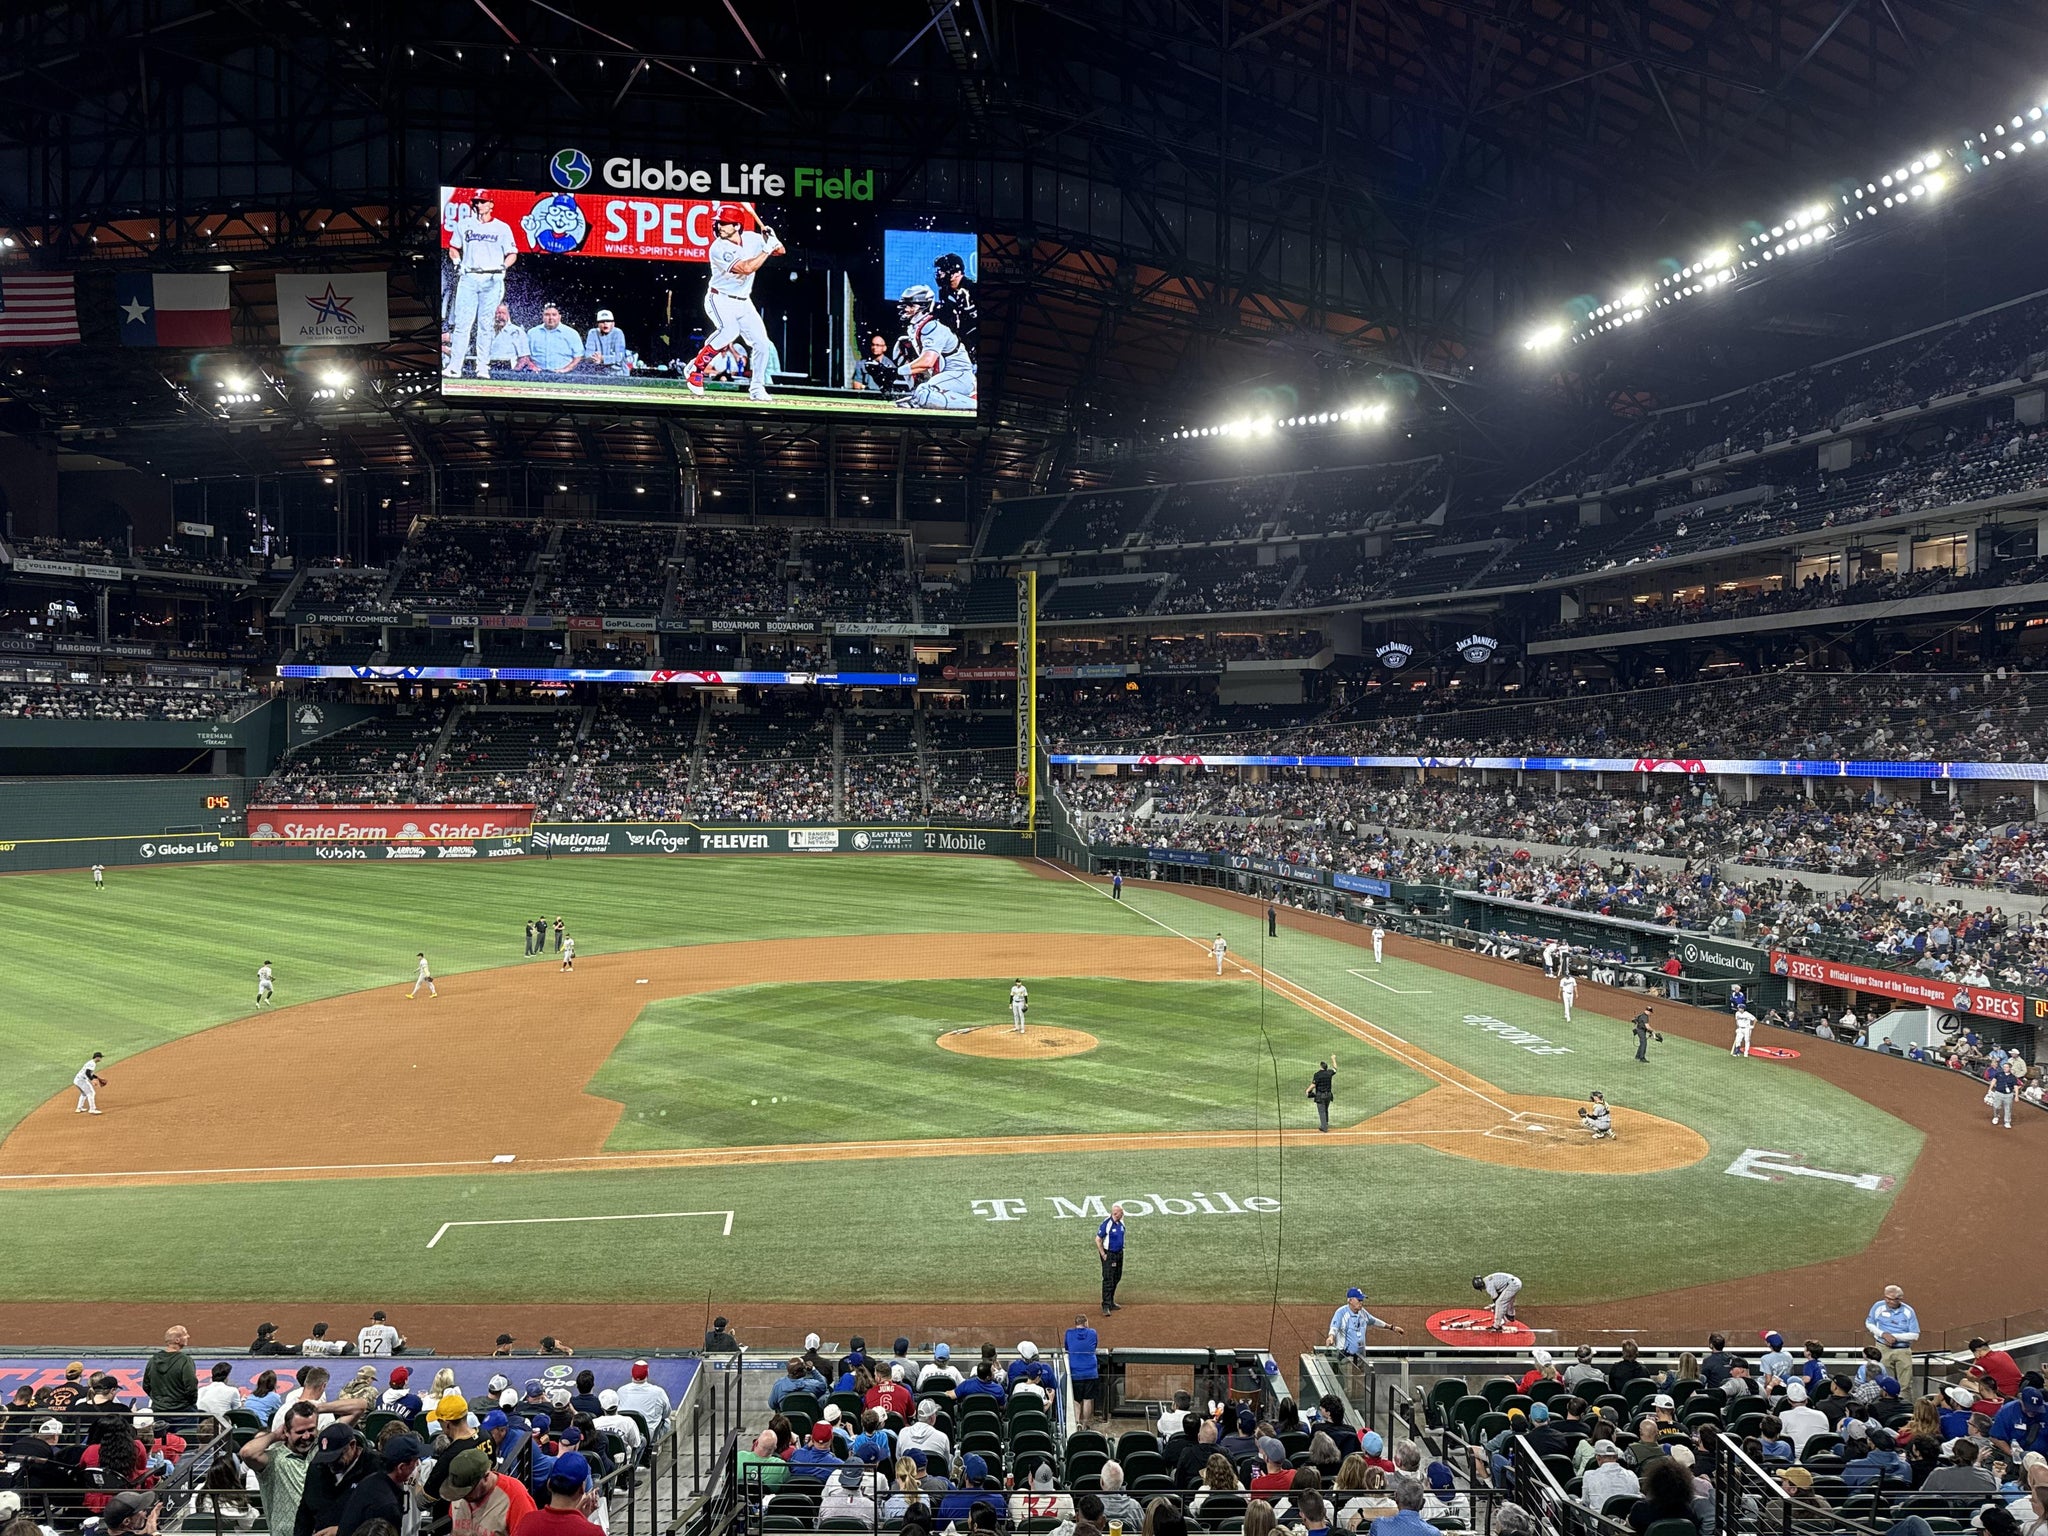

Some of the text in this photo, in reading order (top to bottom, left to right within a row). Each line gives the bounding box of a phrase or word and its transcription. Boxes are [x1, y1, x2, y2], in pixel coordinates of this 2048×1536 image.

[603, 157, 874, 202] Globe Life Field
[605, 244, 706, 258] WINES SPIRITS FINER
[299, 325, 365, 336] ARLINGTON
[319, 614, 399, 624] PRIORITY COMMERCE
[451, 616, 479, 625] 105.3
[481, 616, 503, 626] THE
[578, 619, 600, 628] PGL
[605, 620, 653, 629] GoPGL.com
[666, 621, 687, 629] PGL
[712, 620, 760, 630] BODYARMOR
[767, 622, 814, 632] BODYARMOR
[838, 624, 862, 634] Blue
[1, 640, 35, 650] GOLD
[1018, 601, 1029, 676] CHIKIN
[1456, 634, 1499, 652] JACK DANIEL'S
[56, 643, 151, 655] HARGROVE ROOFING
[169, 649, 228, 660] PLUCKERS
[1375, 641, 1414, 658] JACK DANIEL'S
[1018, 679, 1029, 708] IZ
[207, 796, 229, 809] 0:45
[646, 829, 690, 853] Kroger
[939, 833, 986, 850] Mobile
[1021, 832, 1032, 840] 326
[158, 841, 219, 855] Globe Life
[316, 847, 367, 858] Kubota
[488, 848, 525, 856] HONDA
[1294, 869, 1313, 879] American
[1700, 950, 1755, 974] Medical City
[1791, 961, 1825, 979] SPEC'S
[1830, 969, 1849, 981] Official
[1850, 973, 1867, 986] Liquor
[1868, 976, 1883, 988] Store
[1884, 980, 1891, 989] of
[1892, 982, 1901, 991] the
[1903, 983, 1919, 996] Texas
[1920, 985, 1945, 1000] Rangers
[1976, 995, 2021, 1017] SPEC'S
[1462, 1015, 1553, 1045] Mobile
[1044, 1192, 1281, 1219] Mobile
[363, 1338, 383, 1355] 67
[878, 1384, 895, 1393] JUNG
[880, 1394, 892, 1411] 6
[1023, 1496, 1059, 1519] 32
